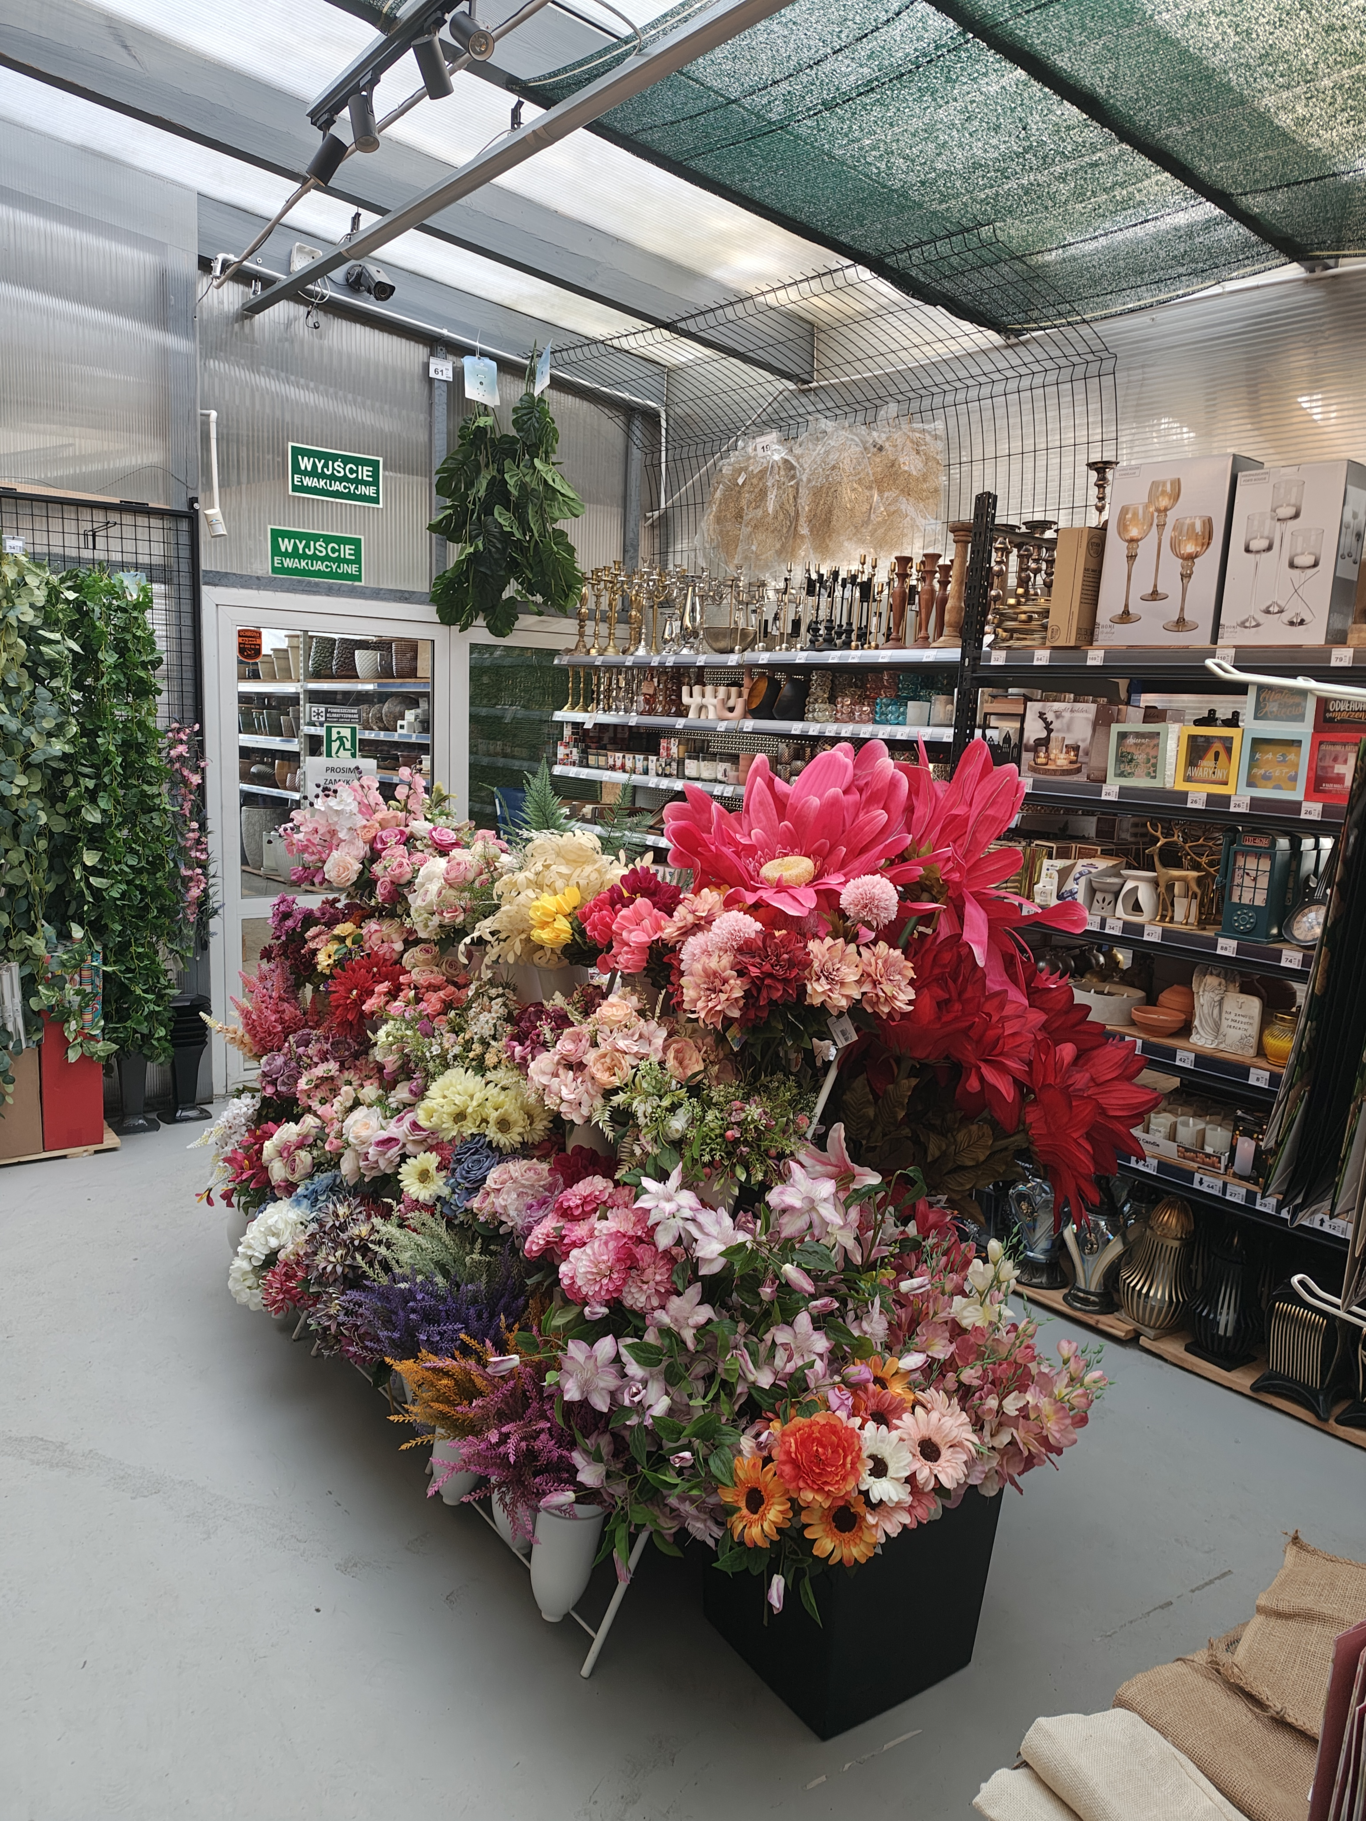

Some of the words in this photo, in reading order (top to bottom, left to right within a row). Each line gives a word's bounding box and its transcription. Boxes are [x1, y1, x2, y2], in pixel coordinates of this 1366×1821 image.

[297, 455, 373, 481] WYJŚCIE
[294, 474, 377, 497] EWAKUACYJNE
[278, 537, 356, 560] WYJŚCIE
[274, 556, 360, 575] EWAKUACYJNE
[1329, 700, 1366, 712] ODKŁADA
[1332, 711, 1366, 720] marzen
[1254, 751, 1296, 762] KASA
[325, 766, 357, 774] PROSIM
[1186, 766, 1228, 779] AWARYJNY
